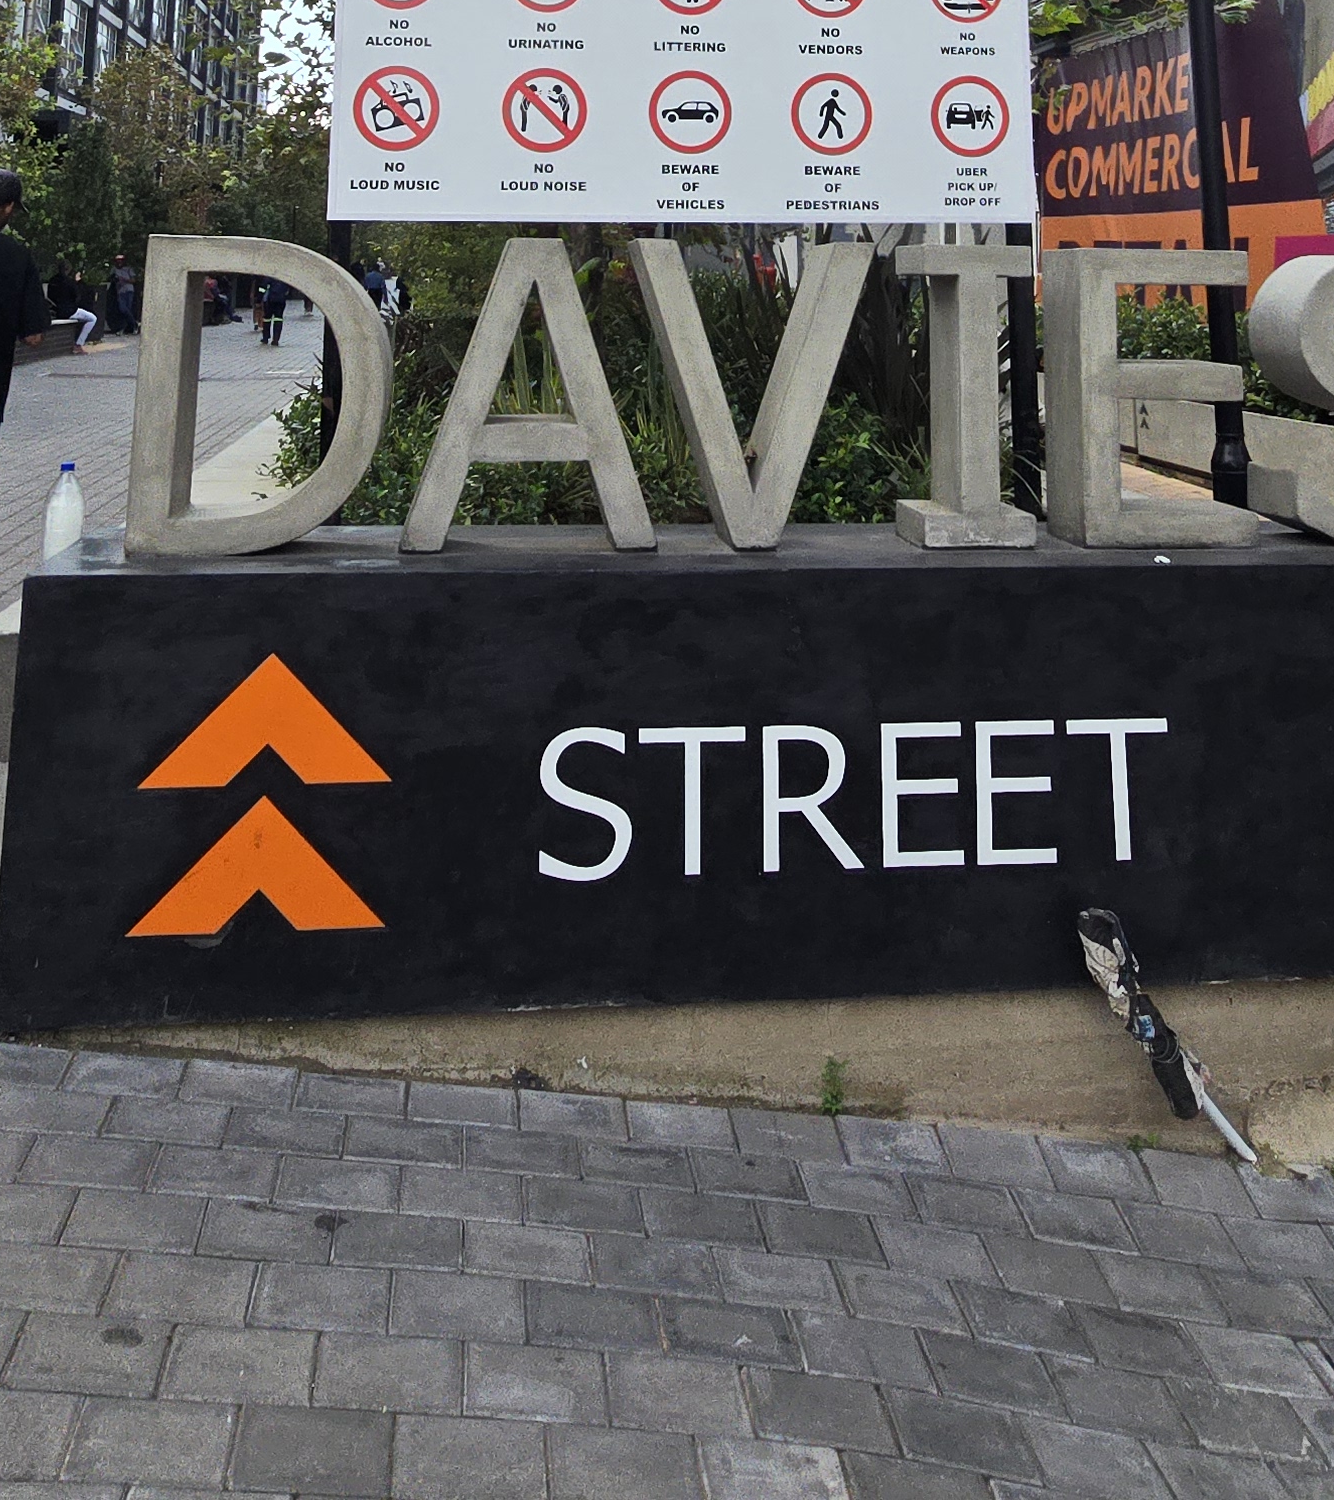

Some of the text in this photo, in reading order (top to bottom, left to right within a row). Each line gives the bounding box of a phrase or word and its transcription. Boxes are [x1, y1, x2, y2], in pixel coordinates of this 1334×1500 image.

[389, 19, 410, 30] NO
[536, 22, 557, 33] NO
[680, 25, 700, 35] NO
[821, 27, 840, 38] NO
[959, 32, 976, 41] NO
[365, 36, 432, 47] ALCOHOL
[508, 39, 584, 50] URINATING
[654, 41, 726, 53] LITTERING
[798, 44, 863, 55] VENDORS
[940, 46, 996, 56] WEAPONS
[1046, 52, 1191, 135] UPMARKE
[1045, 117, 1259, 199] COMMERCL
[384, 162, 405, 173] NO
[534, 163, 554, 174] NO
[661, 164, 719, 175] BEWARE
[804, 165, 861, 176] BEWARE
[956, 167, 988, 177] UBER
[350, 179, 440, 191] LOUD MUSIC
[500, 180, 587, 192] LOUD NOISE
[681, 182, 700, 192] OF
[824, 183, 842, 193] OF
[947, 182, 997, 192] PICK UP/
[656, 199, 725, 210] VEHICLES
[786, 200, 880, 211] PEDESTRIANS
[944, 197, 1001, 207] DROP OFF
[538, 717, 1168, 882] STREET
